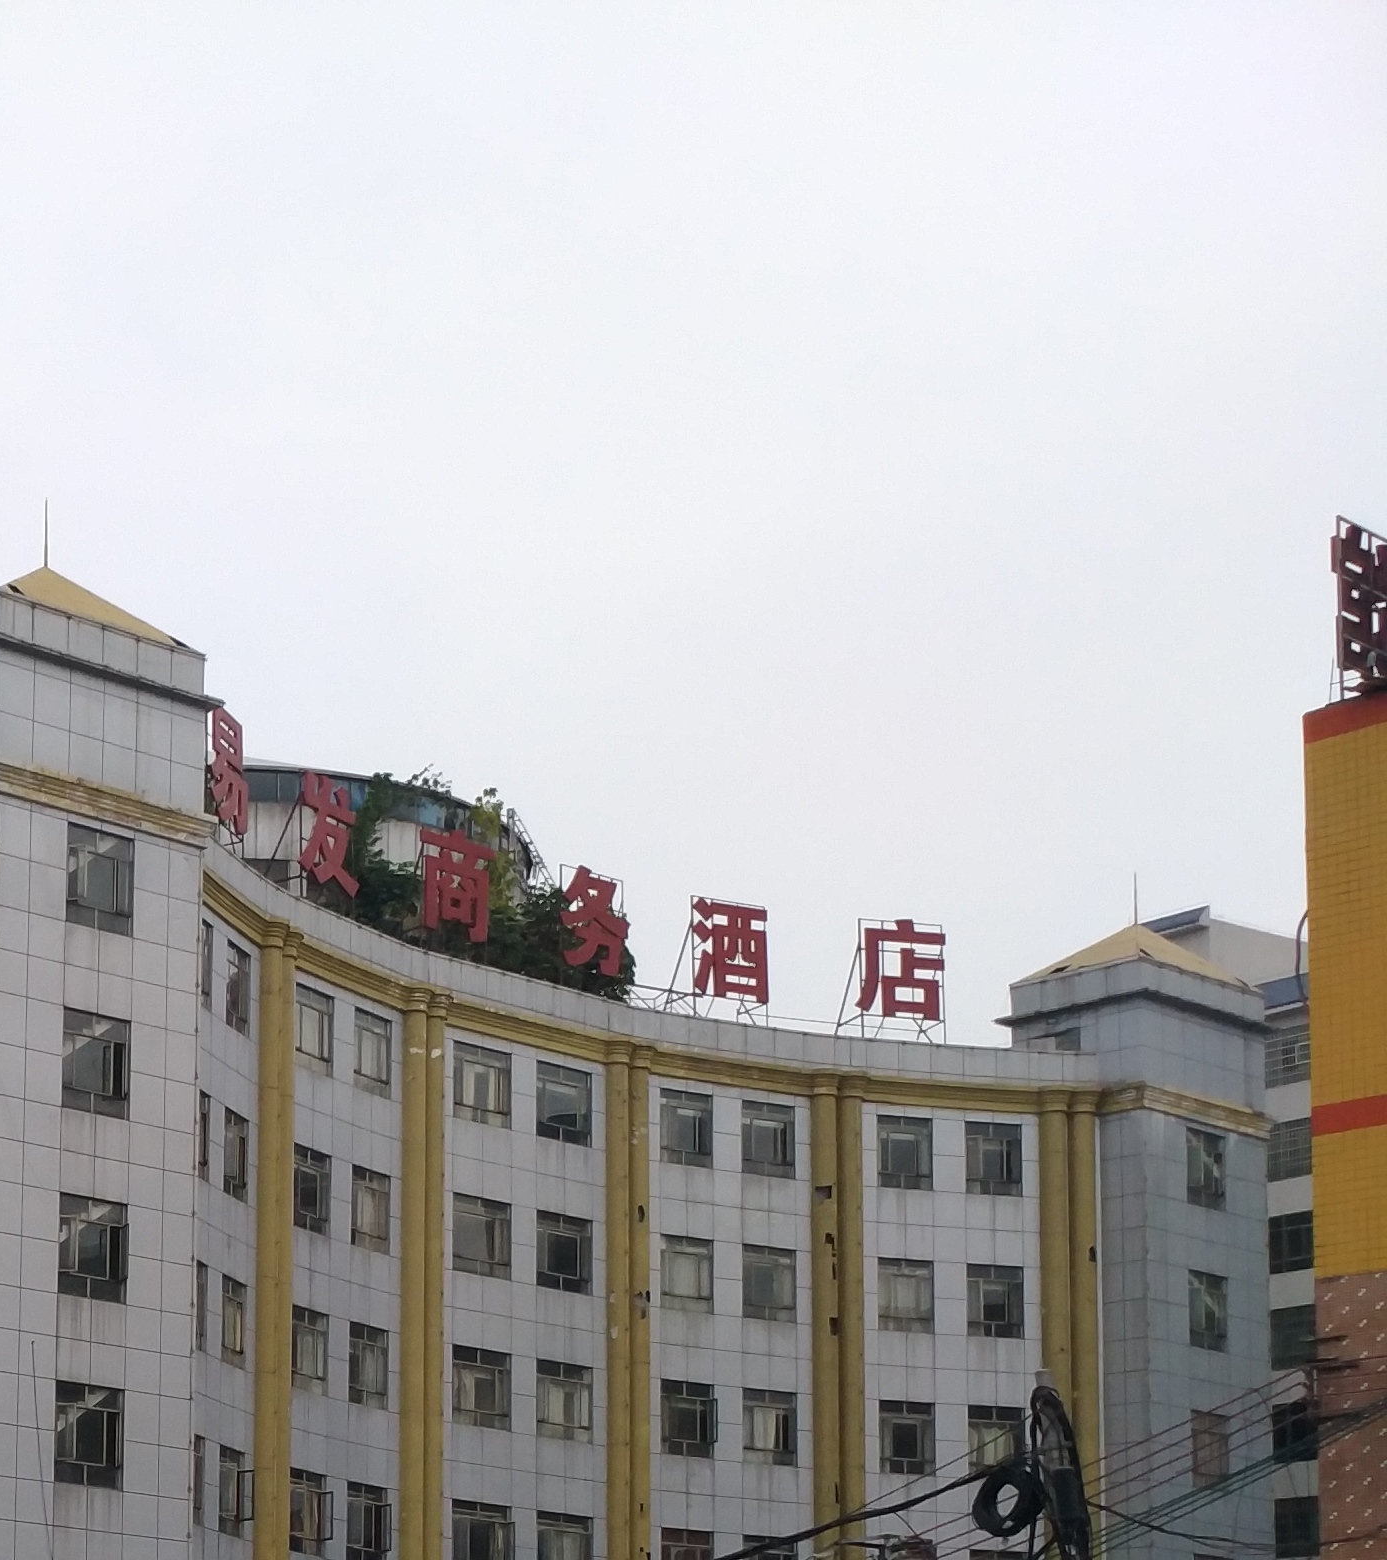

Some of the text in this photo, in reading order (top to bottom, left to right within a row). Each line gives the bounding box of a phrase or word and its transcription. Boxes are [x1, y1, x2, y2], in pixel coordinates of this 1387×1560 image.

[209, 706, 946, 1022] 易发商务酒店
